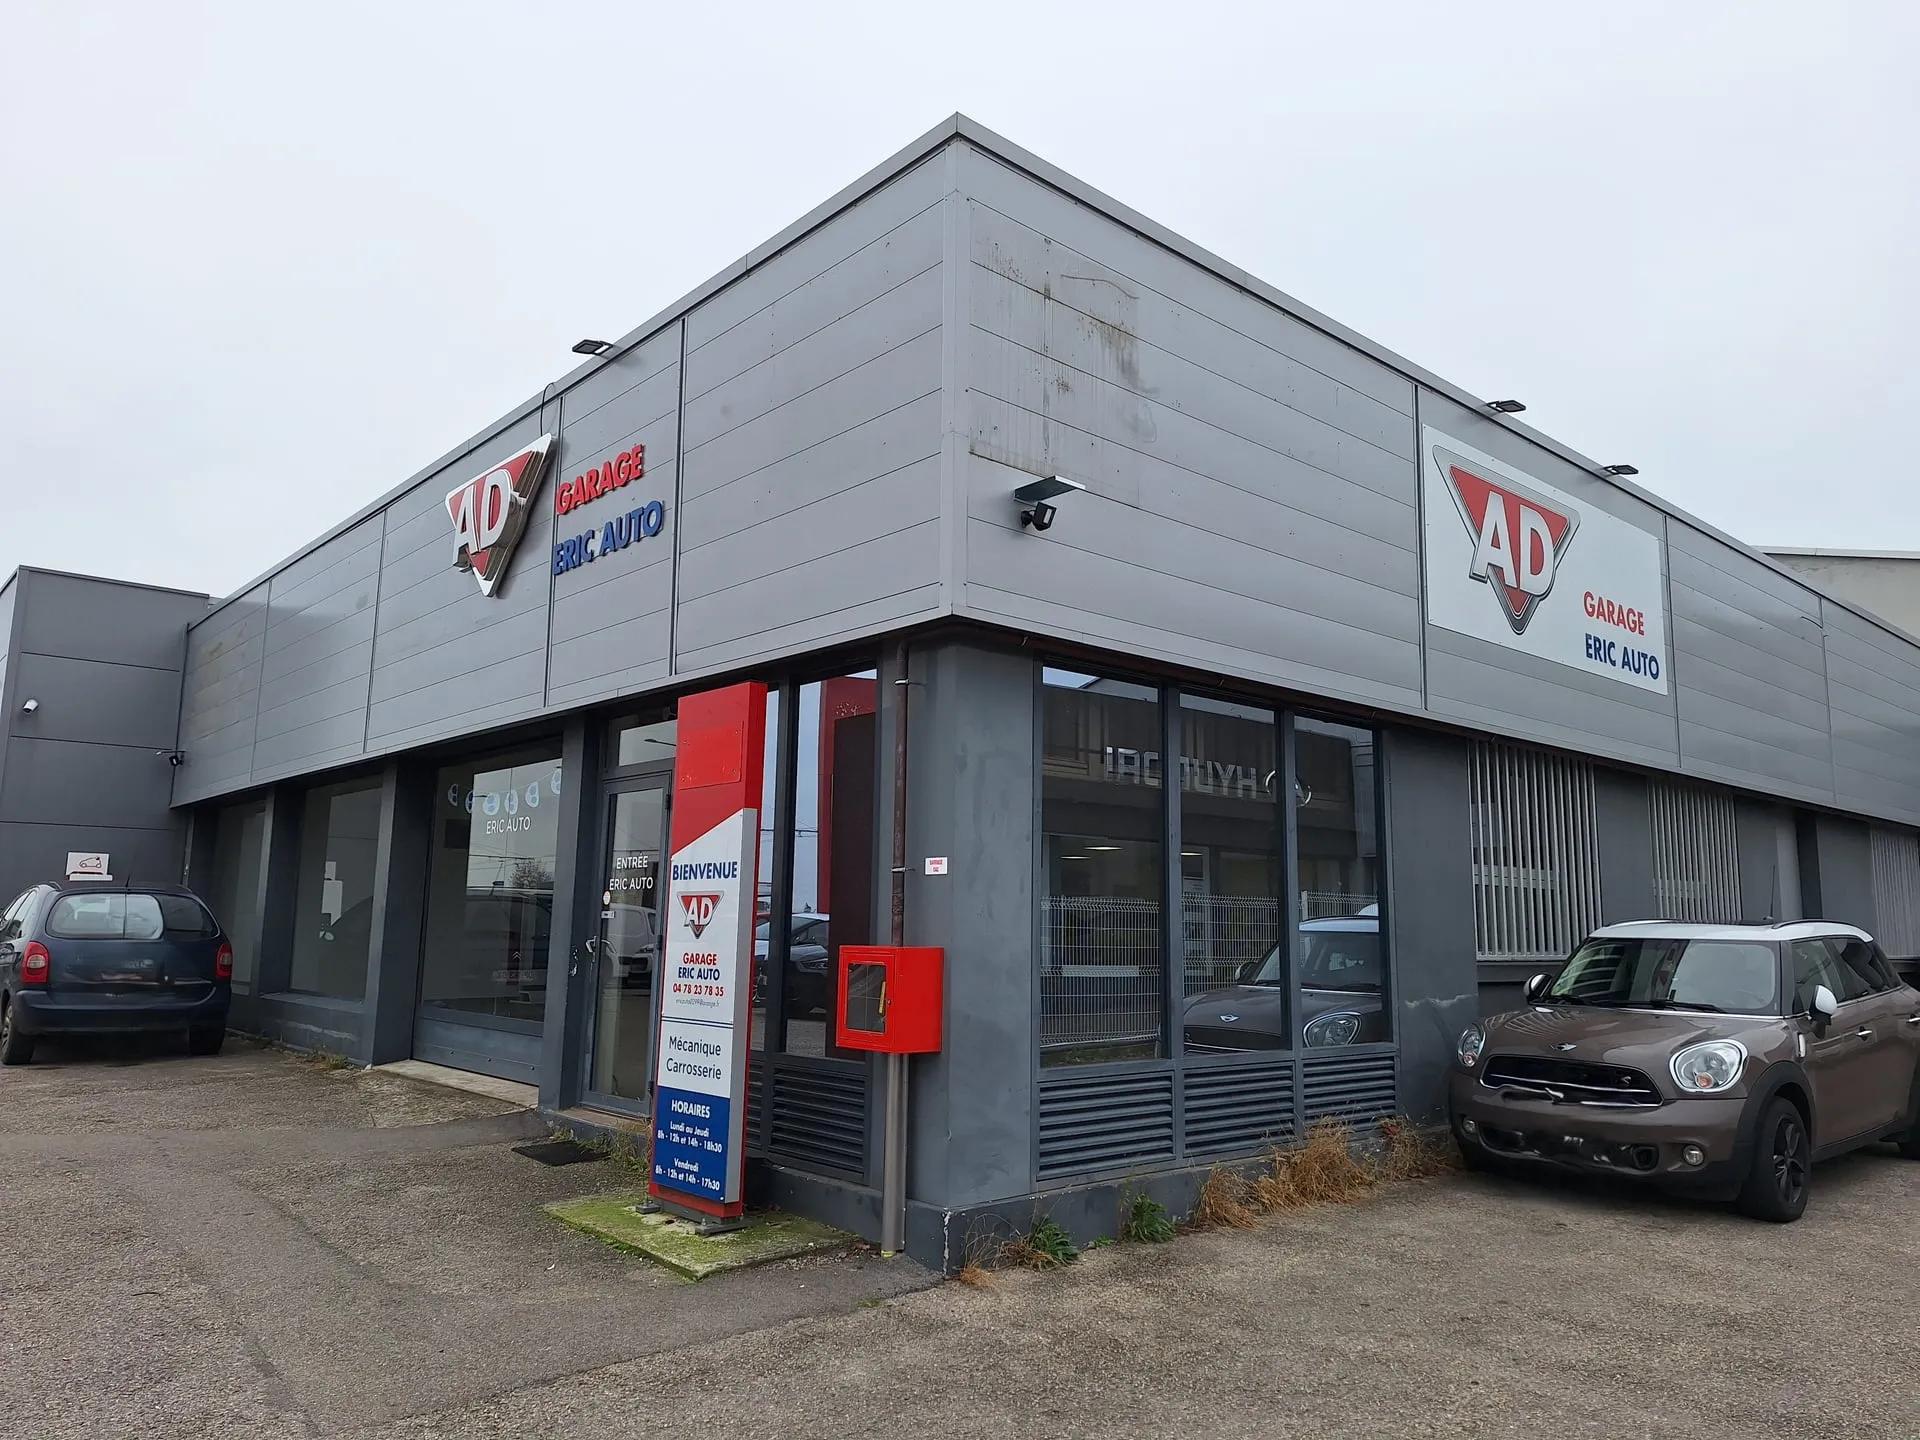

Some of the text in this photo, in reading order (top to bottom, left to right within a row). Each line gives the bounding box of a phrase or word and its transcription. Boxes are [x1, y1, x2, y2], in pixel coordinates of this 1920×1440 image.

[555, 444, 645, 515] GARAGE
[453, 468, 514, 568] AD
[553, 500, 665, 576] ERIC AUTO
[1470, 490, 1555, 597] AD
[1583, 591, 1645, 636] GARAGE
[1585, 632, 1660, 680] ERIC AUTO
[486, 816, 531, 835] ERIC AUTO
[616, 852, 649, 870] ENTRÉE
[672, 861, 738, 881] BIENVENUE
[609, 876, 654, 891] ERIC AUTO
[683, 896, 714, 927] AD
[683, 952, 718, 966] GARAGE
[678, 966, 721, 982] ERIC AUTO
[672, 983, 724, 997] 04 78 23 78 35
[668, 1035, 721, 1057] Mécanique
[666, 1057, 722, 1080] Carrosserie
[671, 1099, 711, 1119] HORAIRES
[670, 1120, 685, 1133] Lundi
[694, 1126, 710, 1138] Jeudi
[669, 1132, 680, 1144] 12h
[688, 1137, 699, 1148] 14h
[704, 1140, 723, 1153] 18h30
[674, 1157, 699, 1173] Vendredi
[667, 1168, 678, 1179] 12h
[685, 1173, 696, 1185] 14h
[701, 1177, 720, 1191] 17h30
